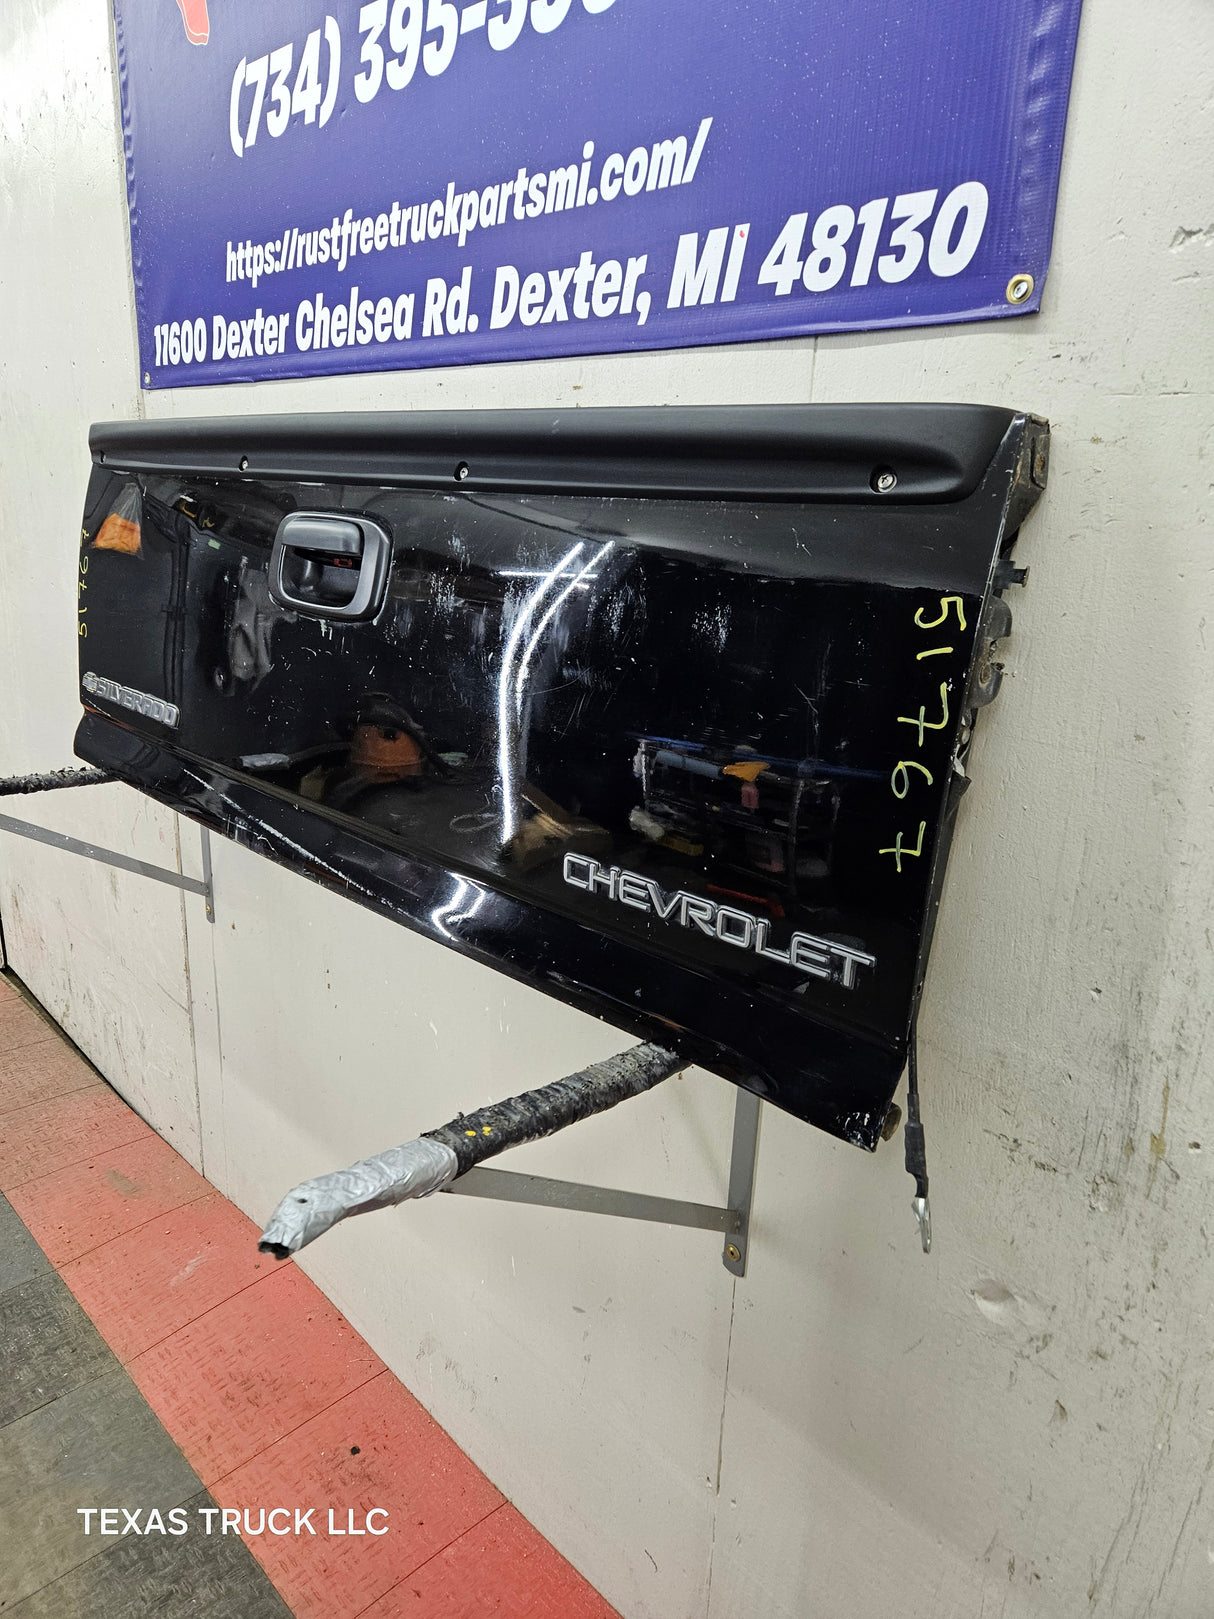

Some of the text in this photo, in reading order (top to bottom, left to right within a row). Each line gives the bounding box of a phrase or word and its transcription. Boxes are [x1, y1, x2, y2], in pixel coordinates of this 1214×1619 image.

[229, 16, 341, 157] (734)
[154, 181, 988, 367] 11600 Dexter Chelsea Rd. Dexter, MI 48130
[226, 117, 713, 288] https://rustfreetruckpartsmi.com/
[97, 676, 180, 729] SILVERADO
[879, 596, 967, 872] 51767
[563, 851, 877, 989] CHEVROLET
